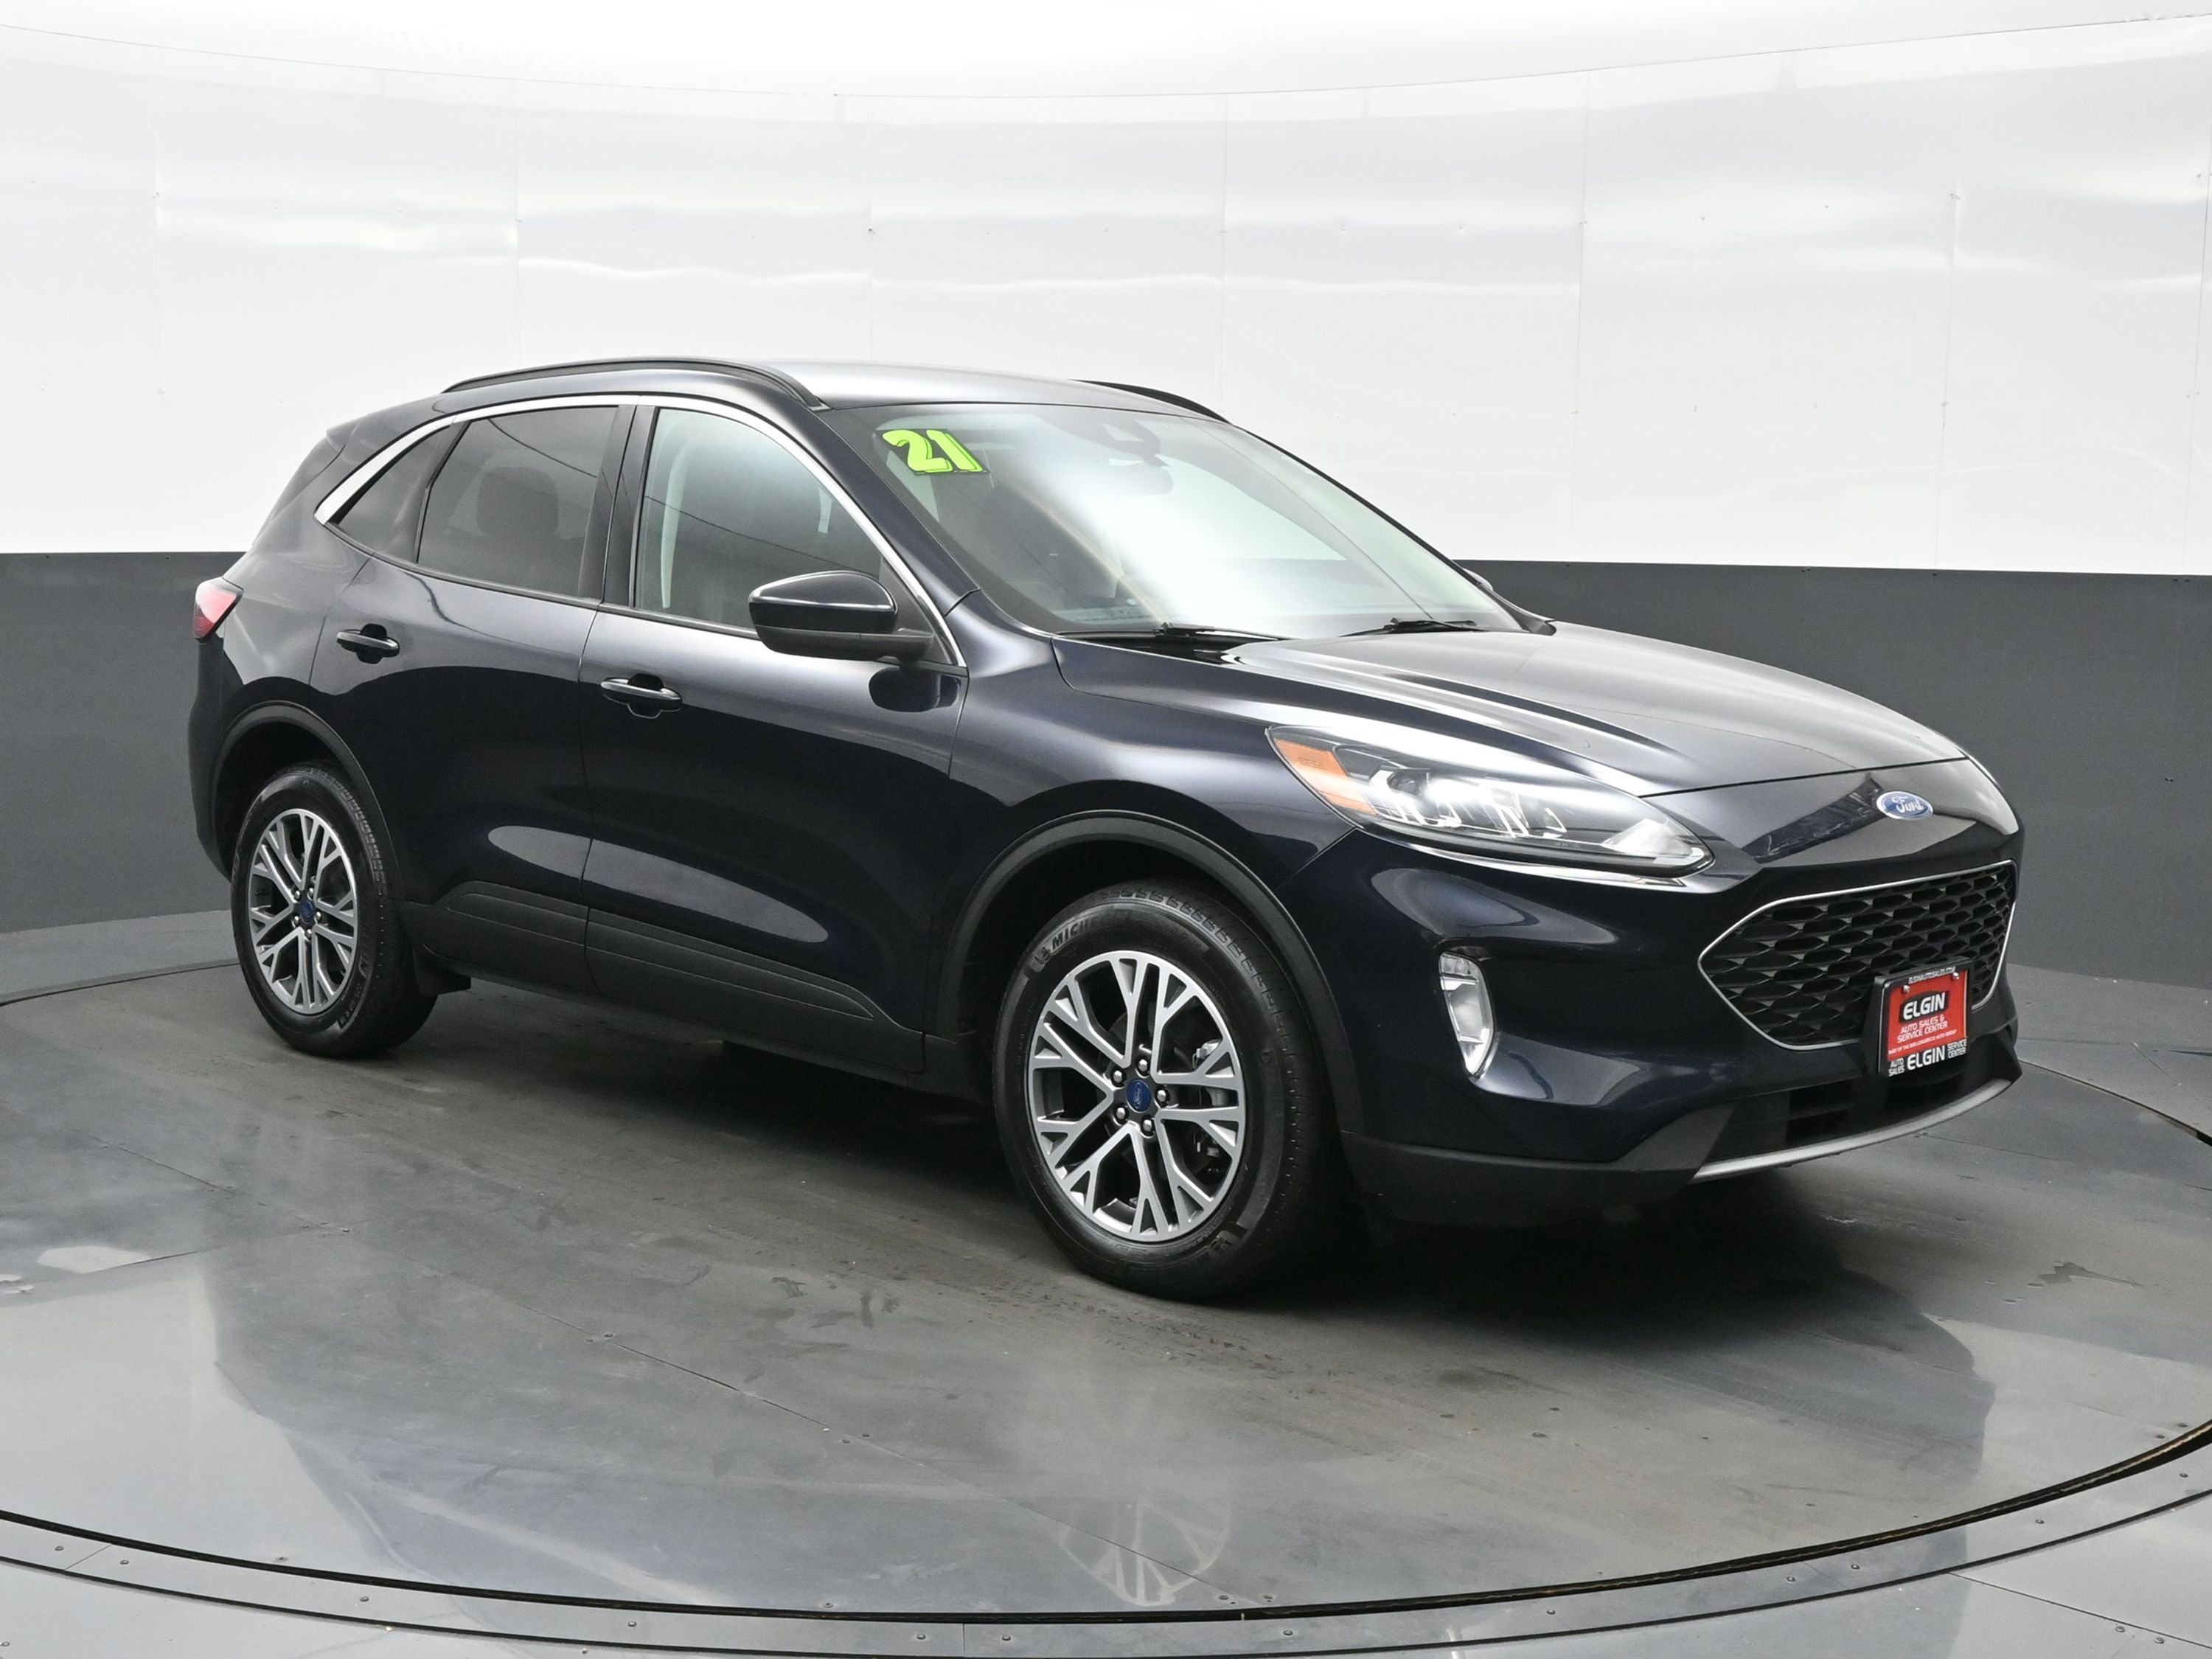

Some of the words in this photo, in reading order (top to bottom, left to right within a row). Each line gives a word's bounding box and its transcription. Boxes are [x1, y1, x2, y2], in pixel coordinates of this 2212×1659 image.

[883, 430, 983, 473] 21
[1891, 796, 1924, 813] Ford
[1903, 992, 1945, 1020] ELGIN
[1897, 1028, 1923, 1043] SERVICE
[1924, 1020, 1948, 1034] CENTER
[1901, 1023, 1917, 1034] AUTO
[1919, 1016, 1938, 1029] SALES
[1940, 1014, 1945, 1022] &
[1947, 1039, 1966, 1051] SERVICE
[1947, 1047, 1966, 1059] CENTER
[1891, 1057, 1904, 1068] AUTO
[1907, 1045, 1945, 1070] ELGIN
[1888, 1065, 1905, 1077] SALES
